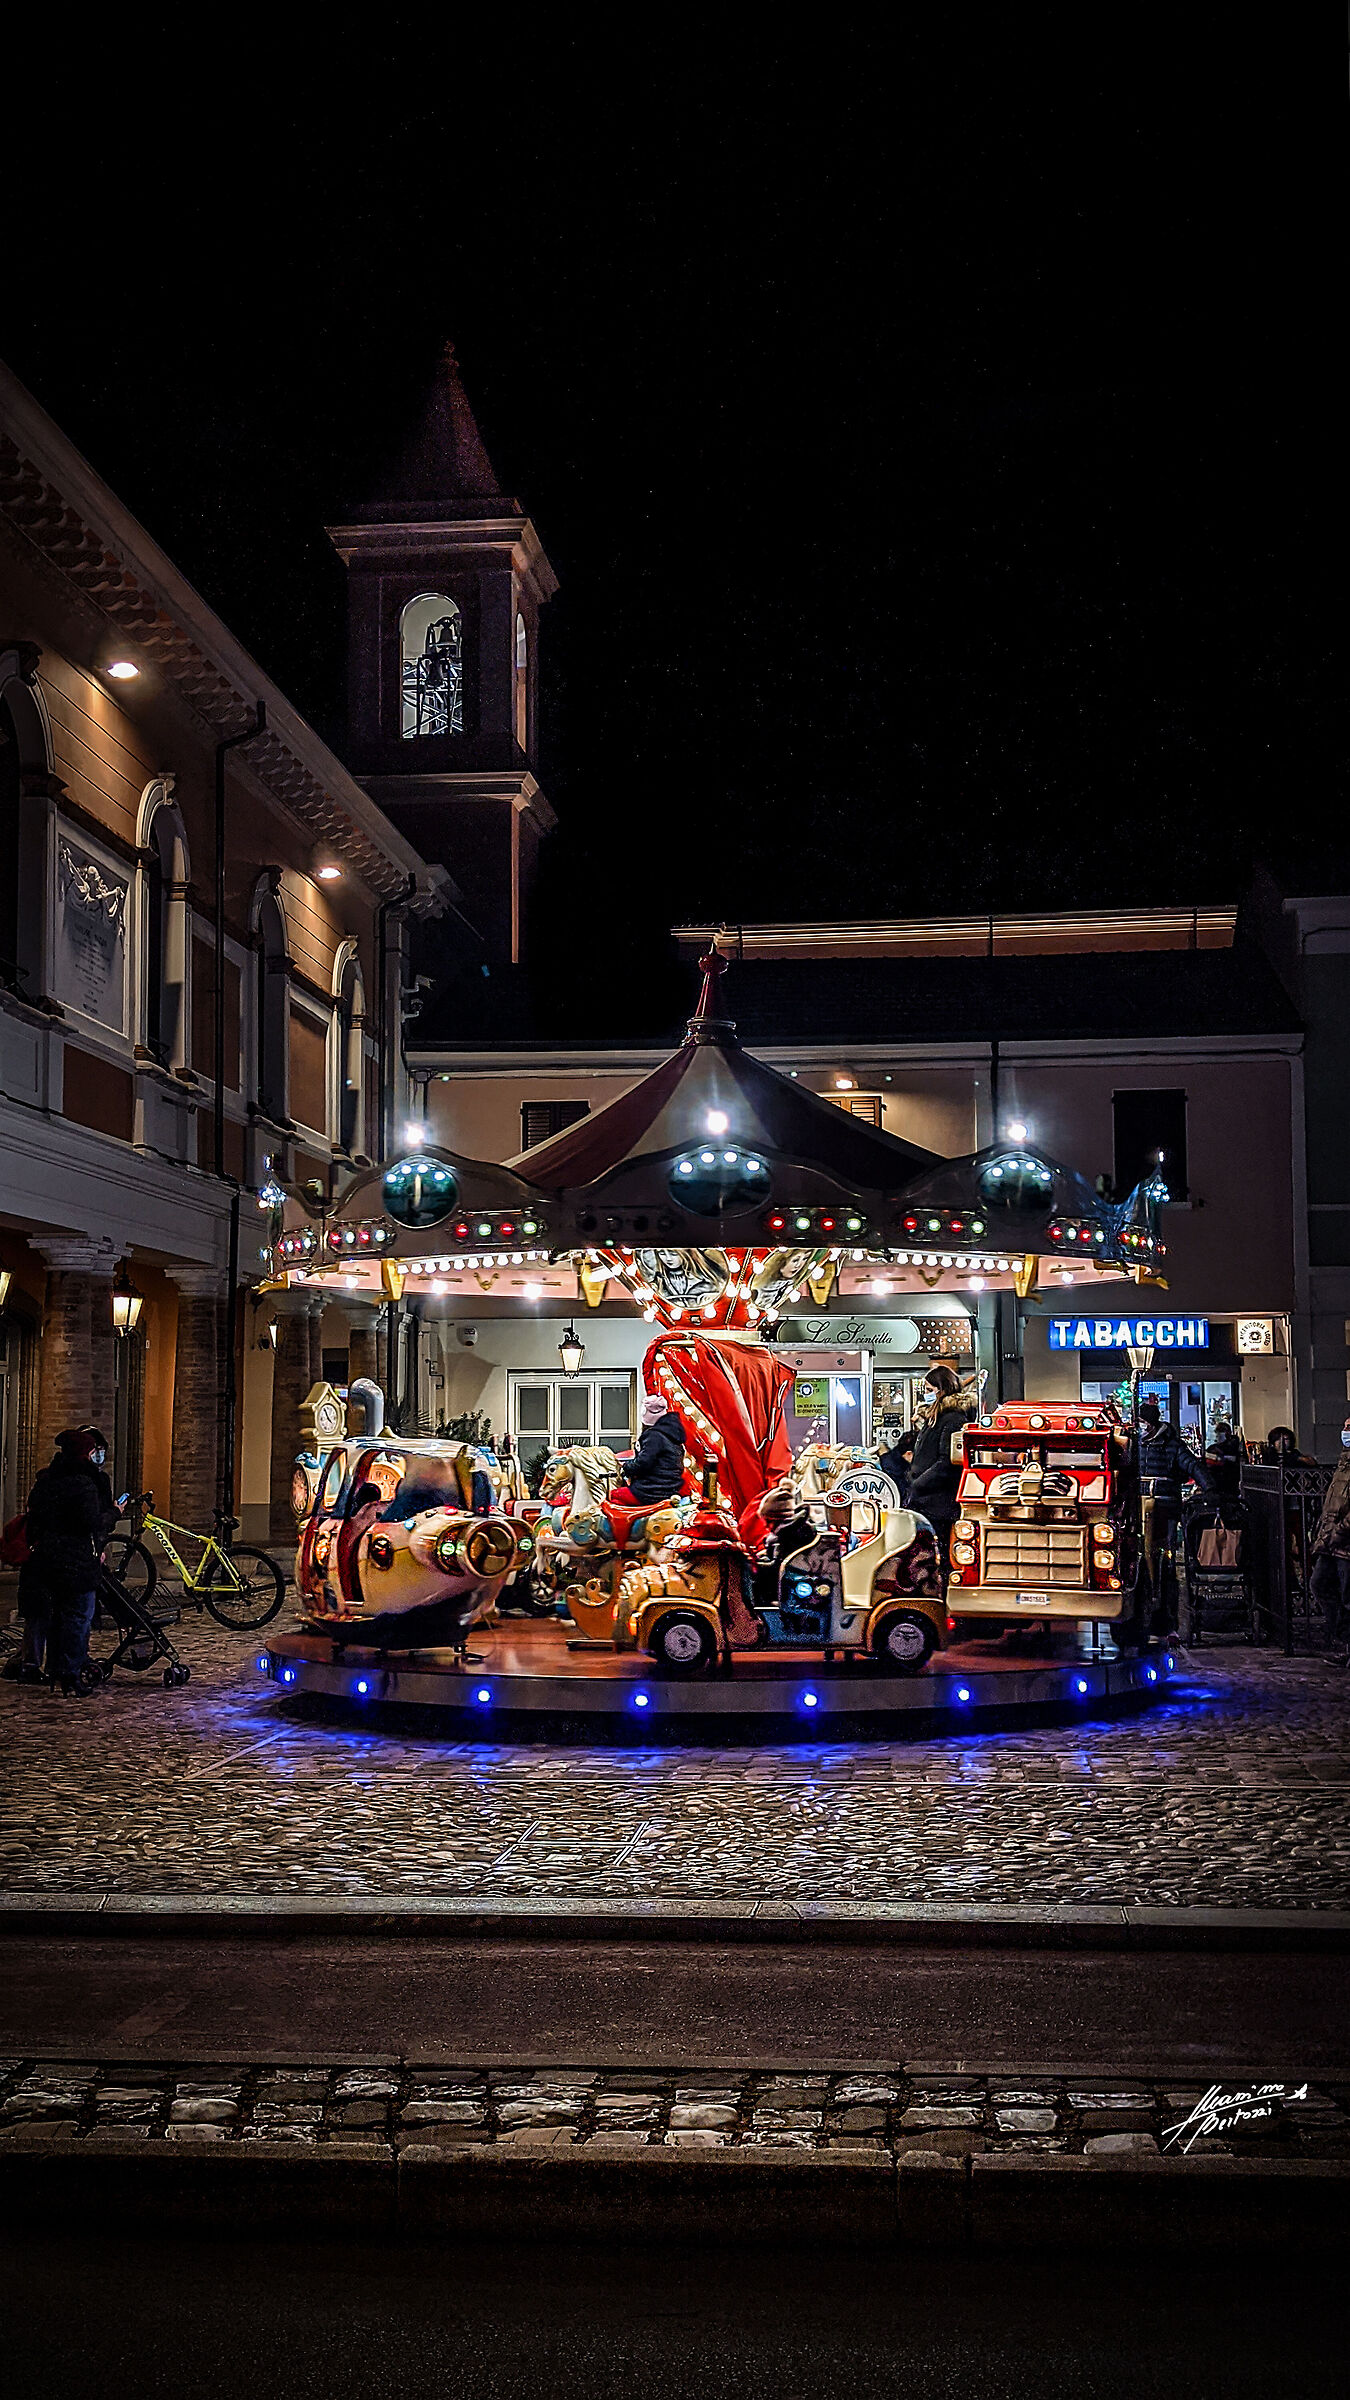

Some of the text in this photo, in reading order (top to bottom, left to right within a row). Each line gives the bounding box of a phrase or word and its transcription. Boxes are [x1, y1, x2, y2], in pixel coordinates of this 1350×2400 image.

[805, 1320, 893, 1344] La Scintilla
[1054, 1320, 1206, 1347] TABACCHI
[151, 1525, 177, 1560] HOGAN
